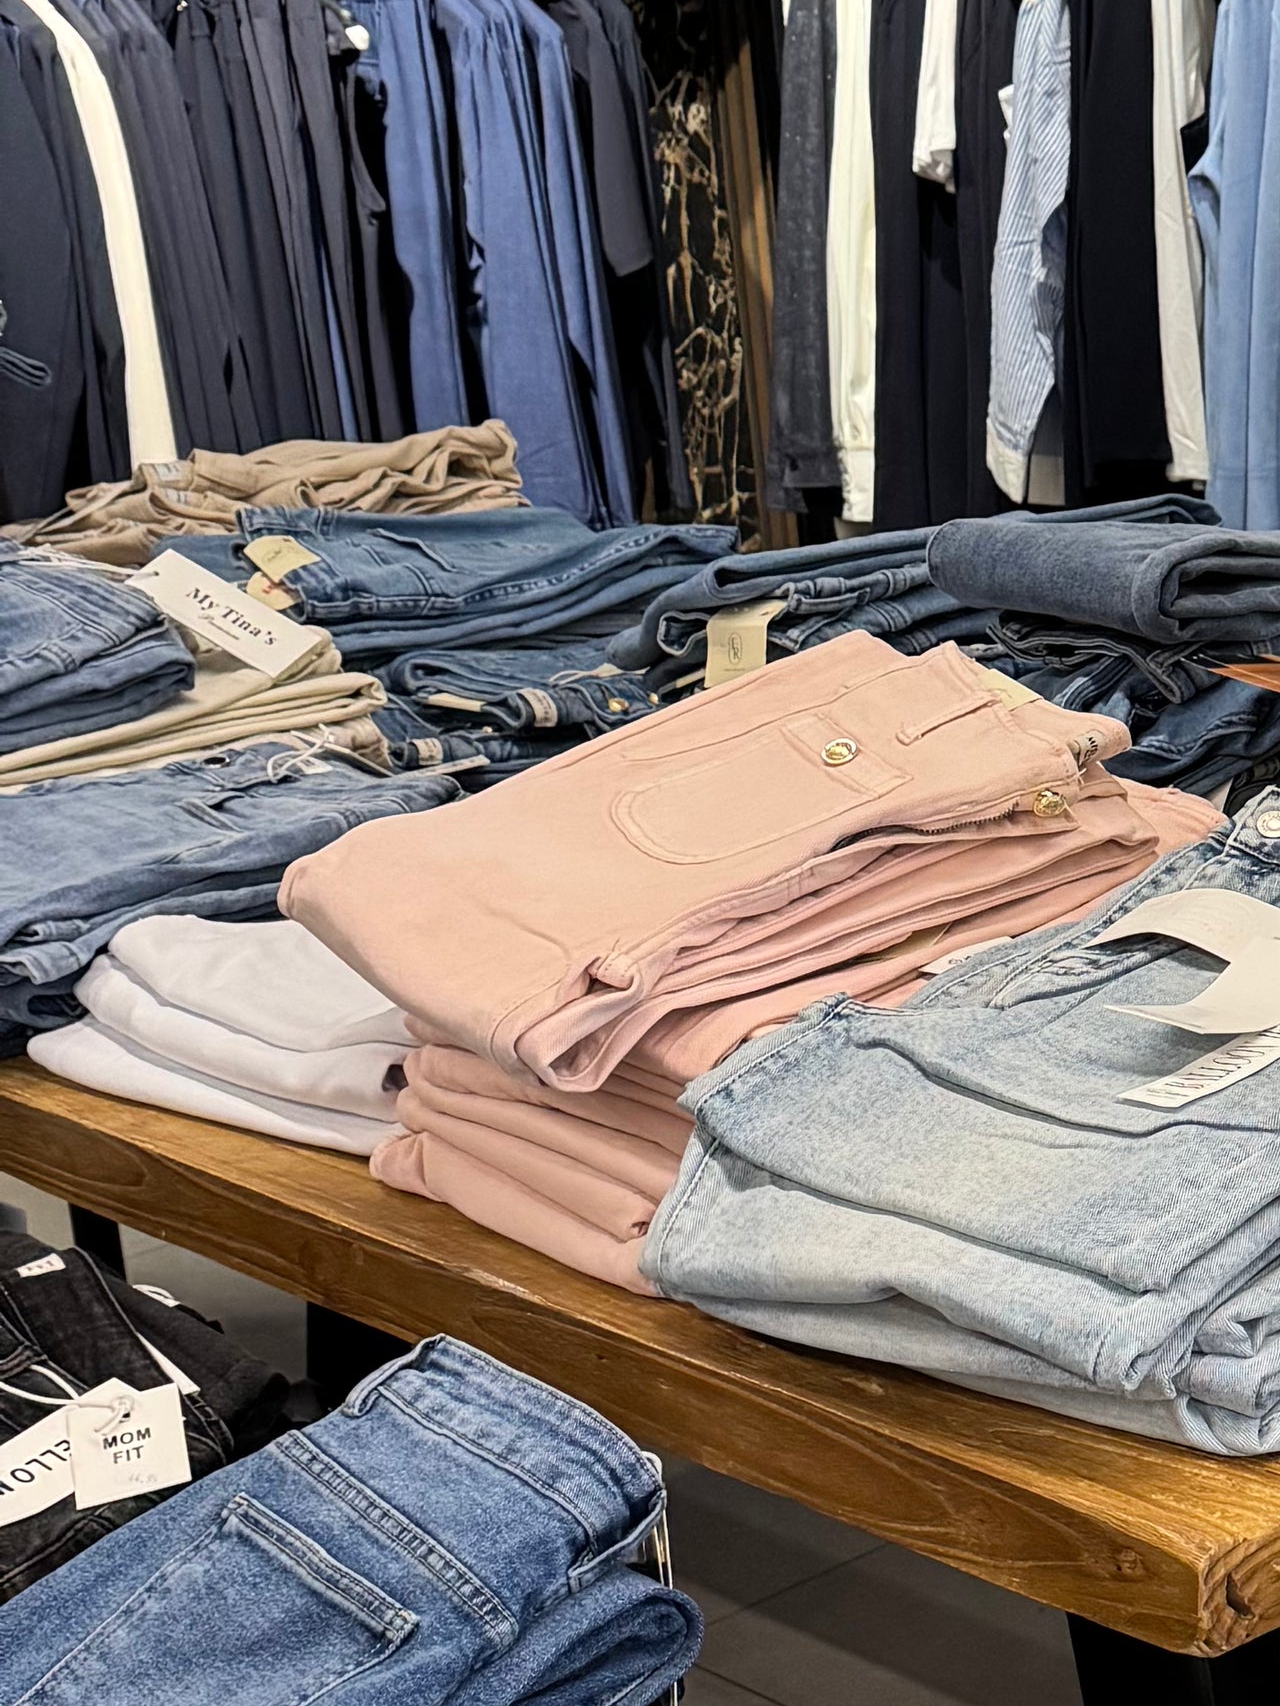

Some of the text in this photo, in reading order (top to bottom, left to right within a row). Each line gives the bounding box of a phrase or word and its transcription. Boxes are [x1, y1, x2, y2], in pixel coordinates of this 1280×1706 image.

[186, 587, 277, 646] My Tina's
[102, 1426, 152, 1450] MOM
[113, 1444, 145, 1465] FIT
